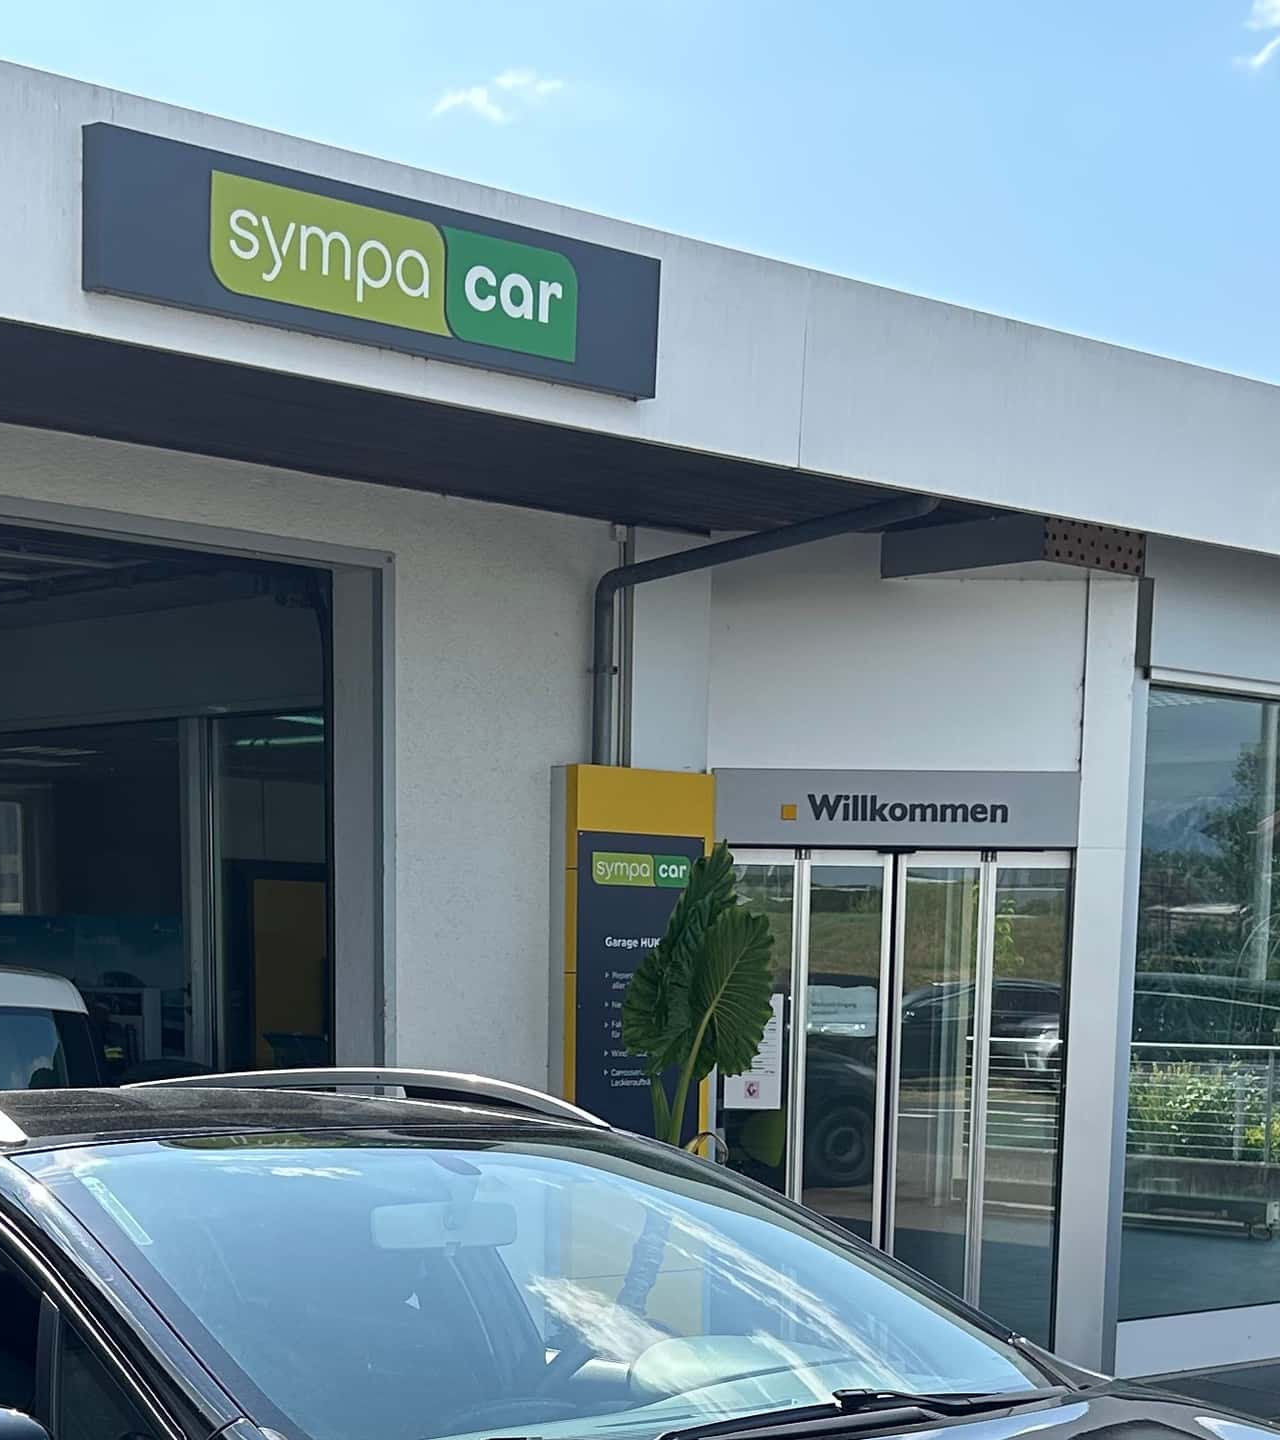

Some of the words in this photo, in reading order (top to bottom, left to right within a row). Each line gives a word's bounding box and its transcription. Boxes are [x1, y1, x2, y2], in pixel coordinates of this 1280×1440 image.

[228, 208, 430, 303] sympa
[464, 264, 563, 324] car
[807, 793, 1009, 823] Willkommen
[596, 860, 650, 881] sympa
[658, 859, 687, 880] car
[605, 936, 639, 949] Garage
